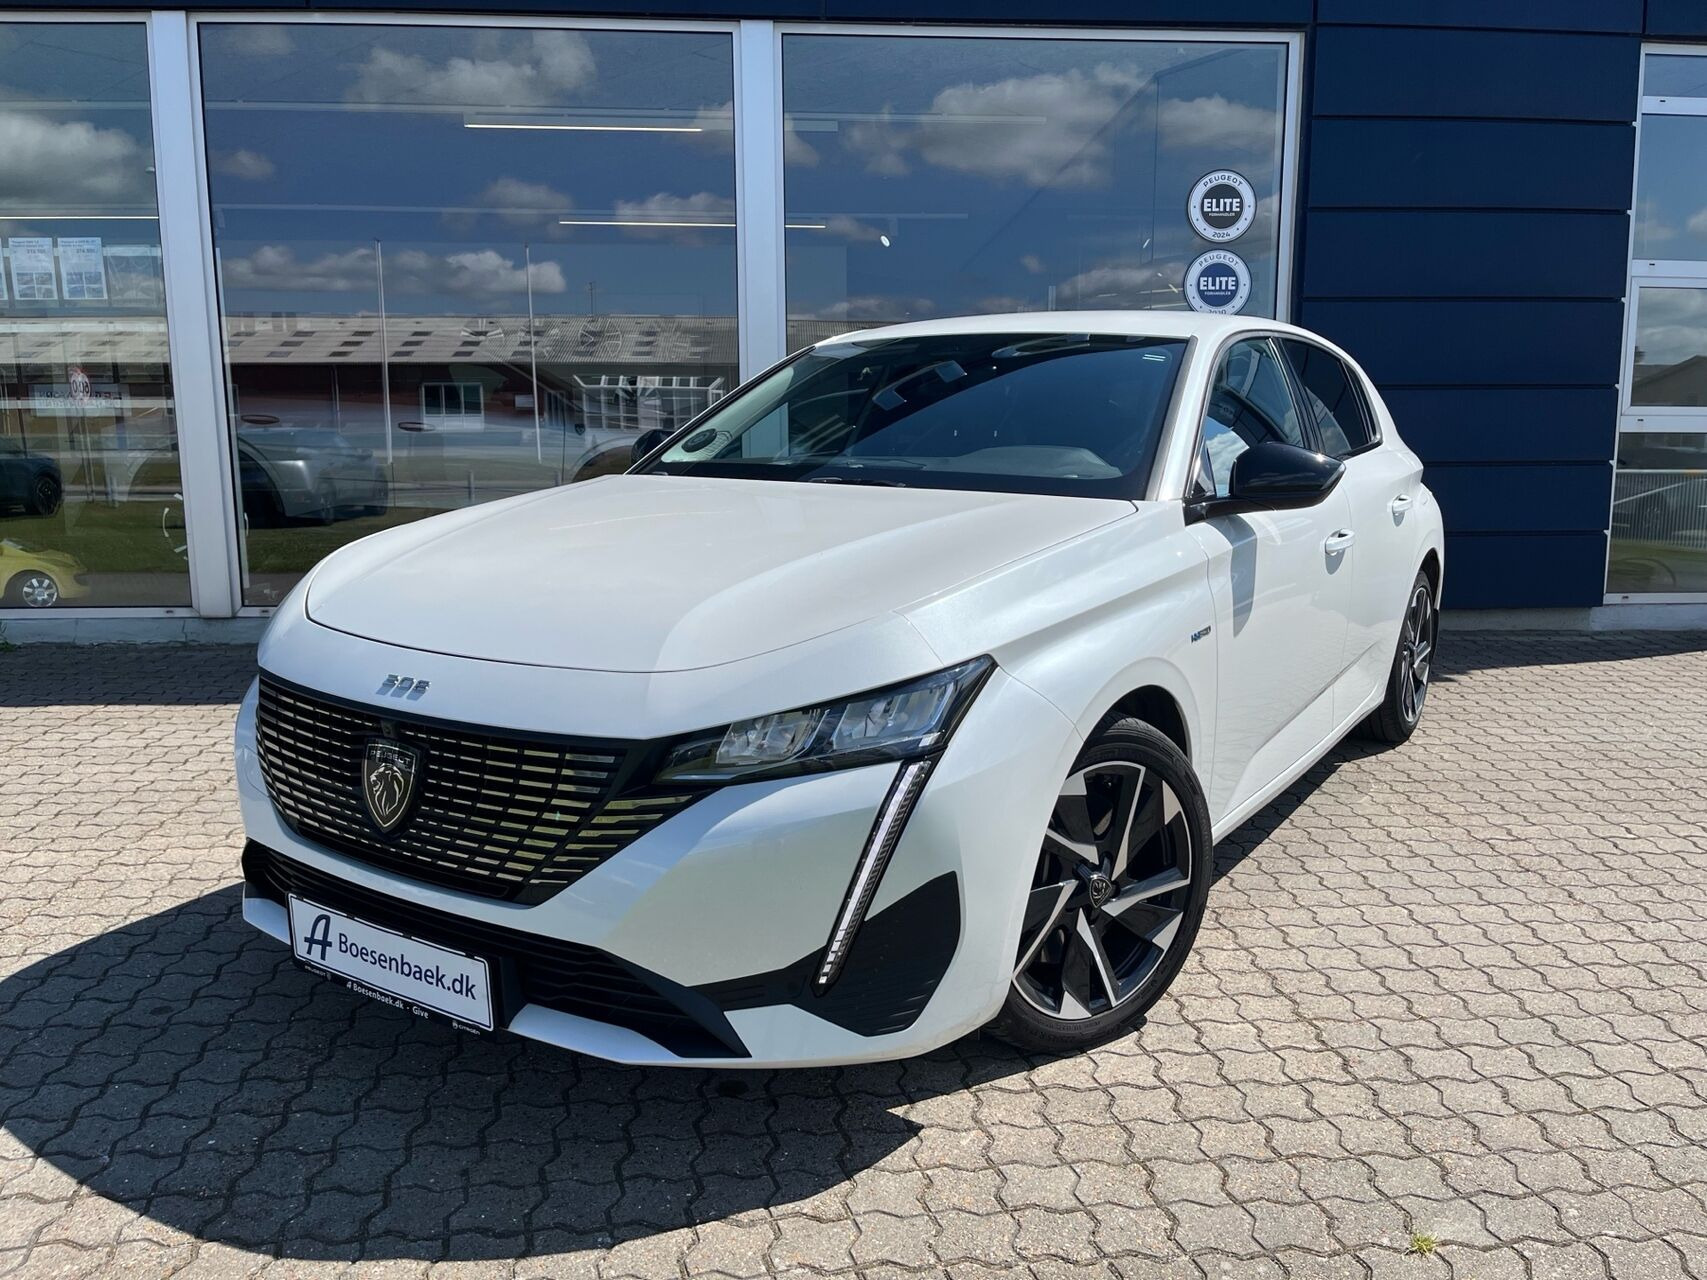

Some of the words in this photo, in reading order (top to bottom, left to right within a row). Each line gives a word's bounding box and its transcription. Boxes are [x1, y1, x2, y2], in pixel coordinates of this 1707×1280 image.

[1203, 174, 1243, 188] PEUGEOT
[1203, 198, 1241, 212] ELITE
[1211, 231, 1231, 239] 2024
[1198, 253, 1239, 268] PEUGEOT
[1199, 276, 1237, 291] ELITE
[304, 914, 332, 960] A
[338, 932, 477, 1001] Boesenbaek.dk
[353, 983, 405, 1010] Boesenbaek.dk
[412, 1006, 429, 1019] Give
